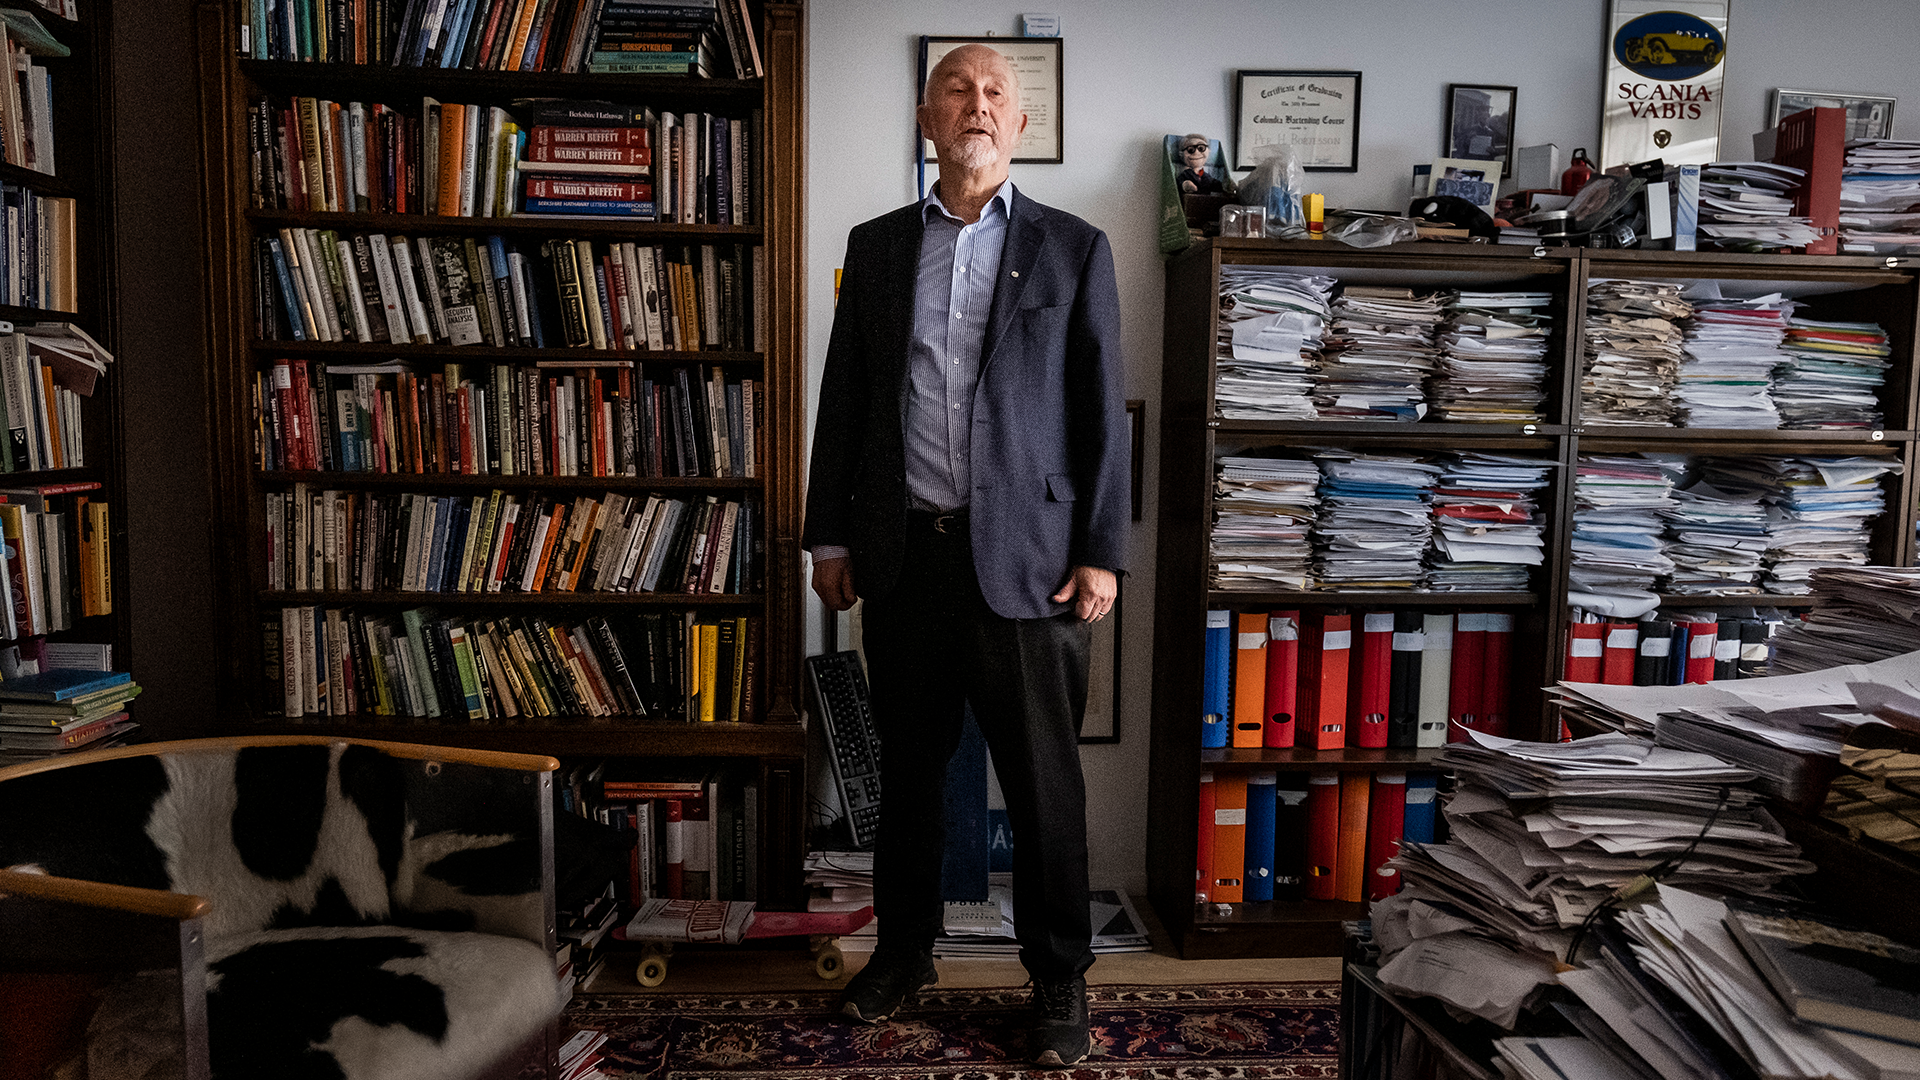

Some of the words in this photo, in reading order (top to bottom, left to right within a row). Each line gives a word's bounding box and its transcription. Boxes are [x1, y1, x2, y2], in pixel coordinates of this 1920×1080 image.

[1260, 85, 1295, 99] Certificate
[1308, 83, 1343, 100] Graduation
[259, 100, 267, 118] TONY
[301, 99, 314, 120] TONY
[1628, 102, 1701, 120] VABIS
[1322, 115, 1345, 125] Course
[260, 119, 270, 146] ROBBINS
[303, 123, 318, 159] ROBBINS
[554, 132, 586, 142] WARREN
[587, 132, 619, 143] BUFFETT
[464, 143, 473, 168] POUND
[554, 150, 586, 160] WARREN
[589, 151, 622, 161] BUFFETT
[463, 170, 471, 201] FOOLISH
[553, 185, 587, 195] WARREN
[588, 187, 623, 197] BUFFETT
[352, 234, 370, 273] Clayton
[374, 238, 385, 256] Dear
[683, 272, 691, 297] WARREN
[446, 307, 472, 317] SECURITY
[447, 314, 474, 325] ANALYSIS
[505, 317, 514, 332] Work
[527, 374, 541, 421] INVESTMENT
[529, 421, 541, 461] ALL-STARS
[555, 528, 563, 545] RICH
[303, 608, 312, 628] John
[286, 635, 295, 664] TRADING
[303, 630, 313, 654] Bogle
[286, 666, 295, 696] SECRETS
[992, 823, 1014, 850] Å
[735, 818, 745, 884] KONSULTERNA
